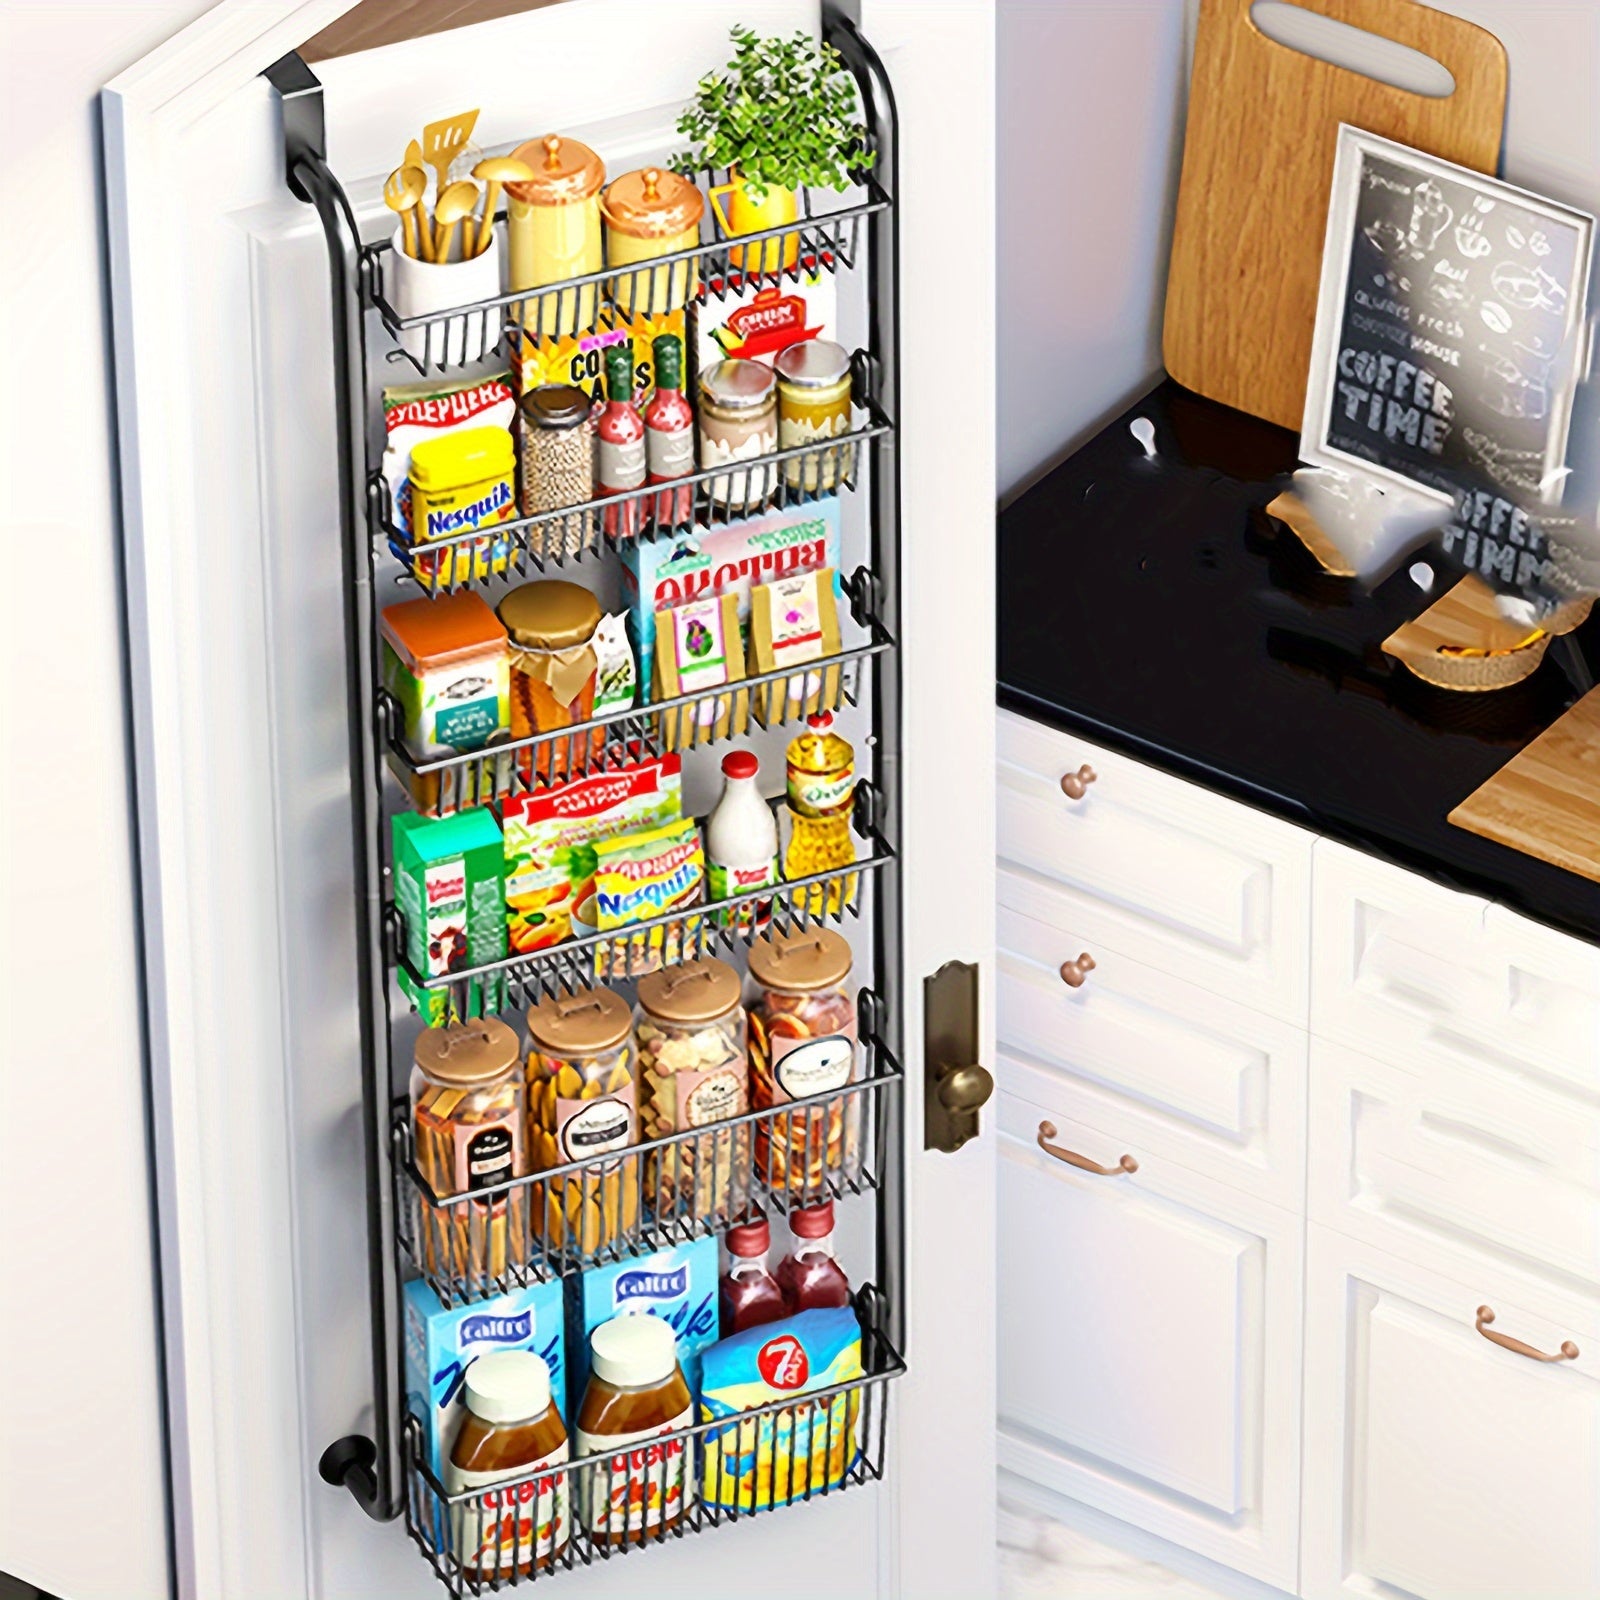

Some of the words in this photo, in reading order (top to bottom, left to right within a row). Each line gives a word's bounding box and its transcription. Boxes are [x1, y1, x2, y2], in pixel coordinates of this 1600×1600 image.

[1339, 347, 1454, 420] COFFEE
[1338, 380, 1452, 456] TIME
[427, 482, 511, 537] Nesquik
[597, 864, 699, 916] Nesquik
